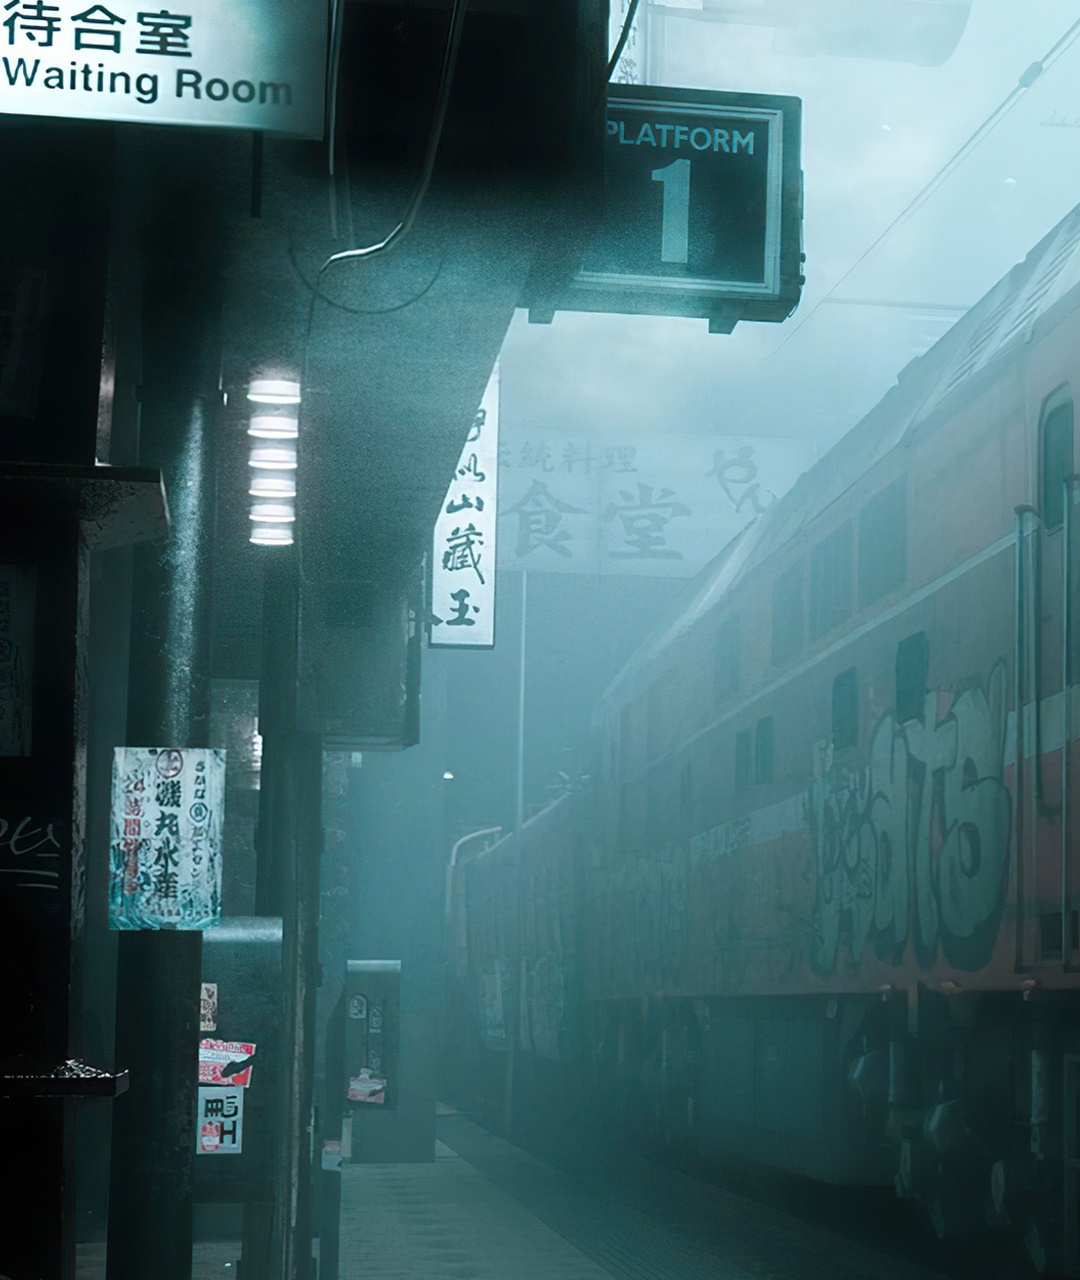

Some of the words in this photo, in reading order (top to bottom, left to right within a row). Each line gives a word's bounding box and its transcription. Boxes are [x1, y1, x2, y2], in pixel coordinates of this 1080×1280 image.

[2, 56, 159, 104] Waiting
[176, 67, 293, 106] Room
[606, 120, 755, 155] PLATFORM
[651, 158, 691, 264] 1
[500, 478, 692, 561] 食堂
